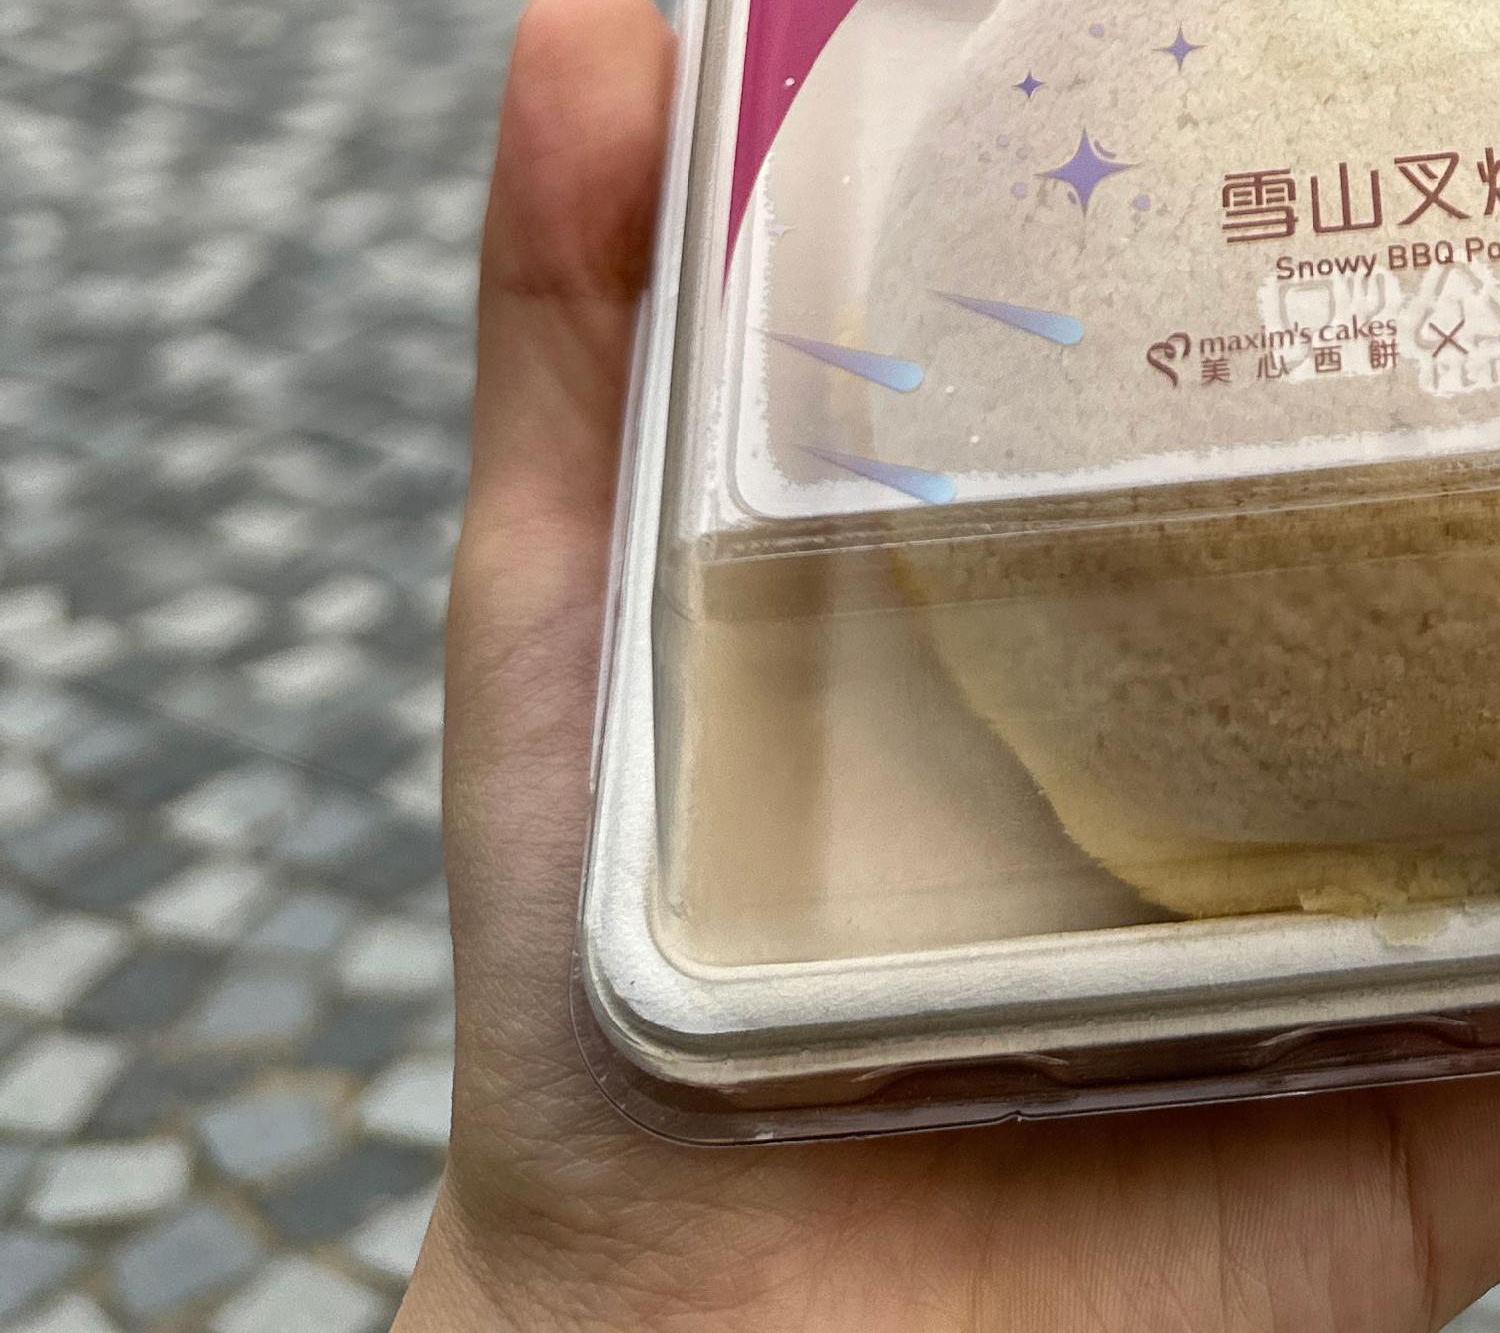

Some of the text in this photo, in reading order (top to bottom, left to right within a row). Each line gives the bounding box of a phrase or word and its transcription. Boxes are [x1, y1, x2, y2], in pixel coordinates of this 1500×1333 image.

[1276, 253, 1378, 280] Snowy
[1387, 240, 1455, 271] BBQ
[1200, 314, 1398, 355] maxim's cakes
[1200, 337, 1400, 384] 美心西餅
